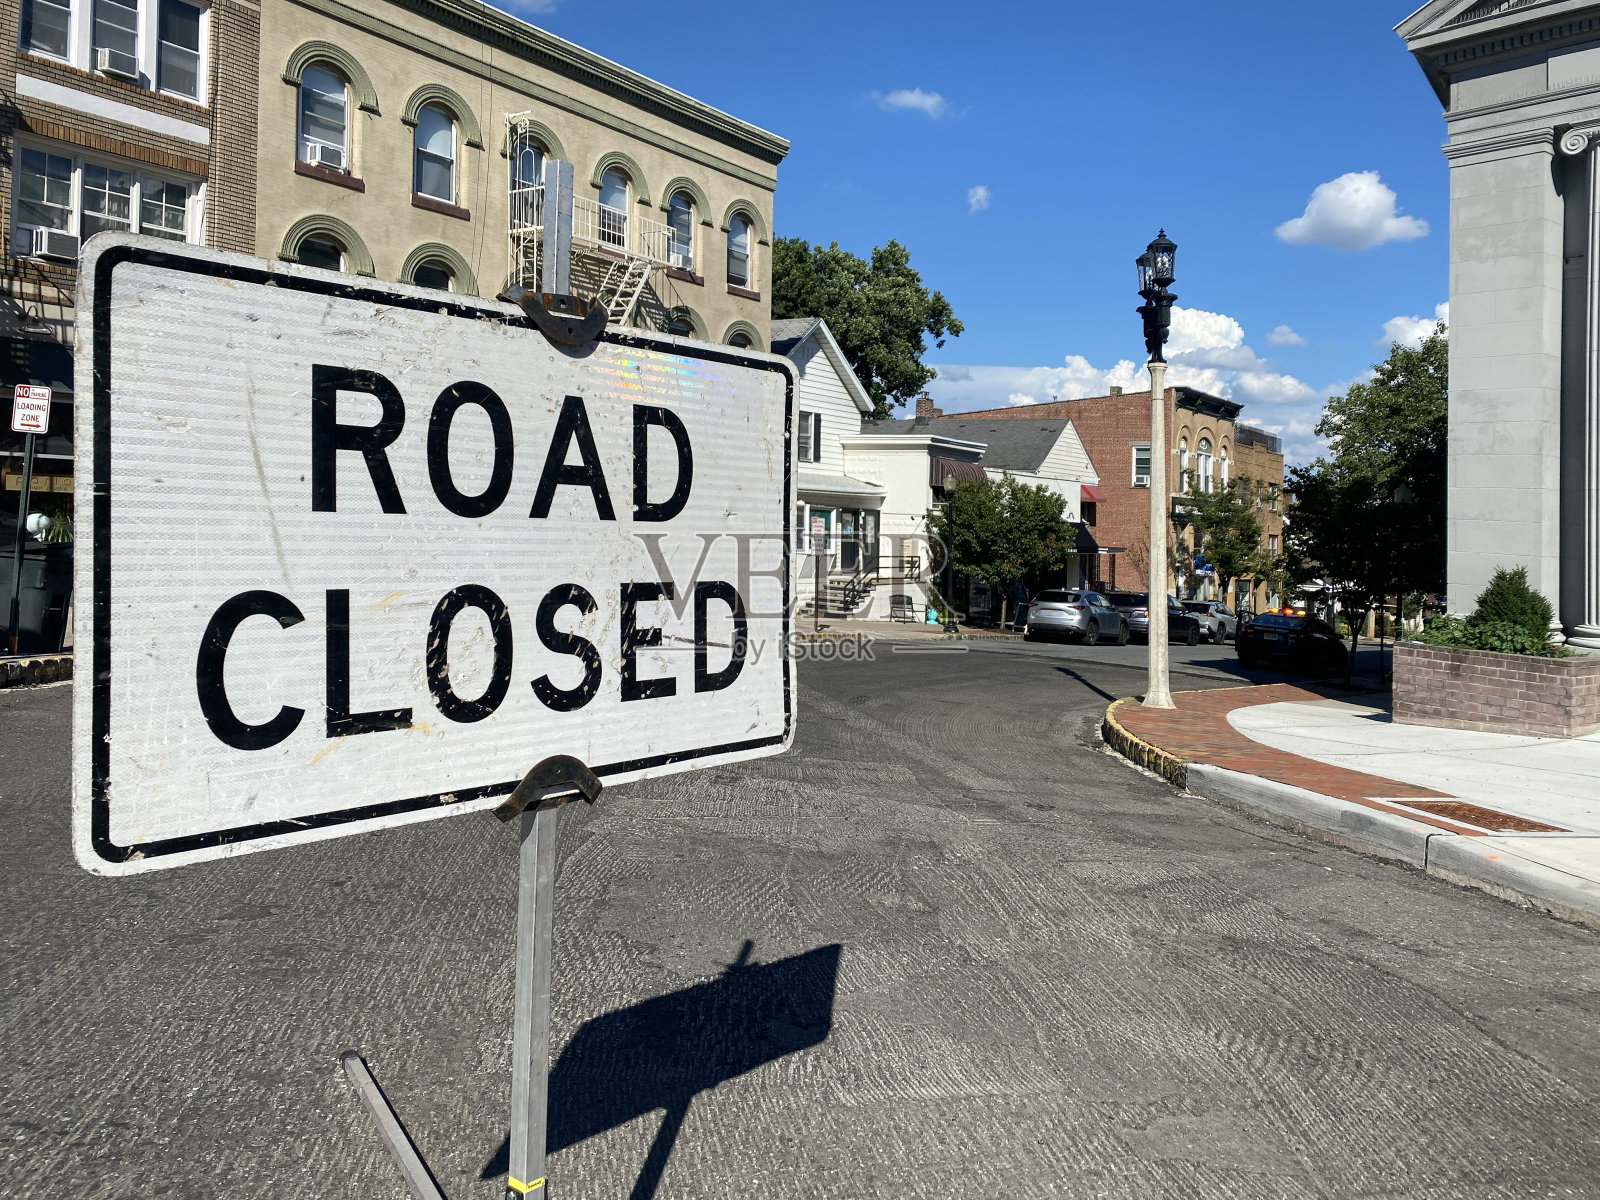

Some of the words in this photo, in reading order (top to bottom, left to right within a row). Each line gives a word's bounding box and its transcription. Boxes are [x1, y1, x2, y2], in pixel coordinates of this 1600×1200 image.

[17, 386, 30, 397] NO
[17, 402, 46, 412] LOADING
[21, 413, 40, 422] ZONE
[311, 363, 694, 523] ROAD
[196, 580, 749, 751] CLOSED
